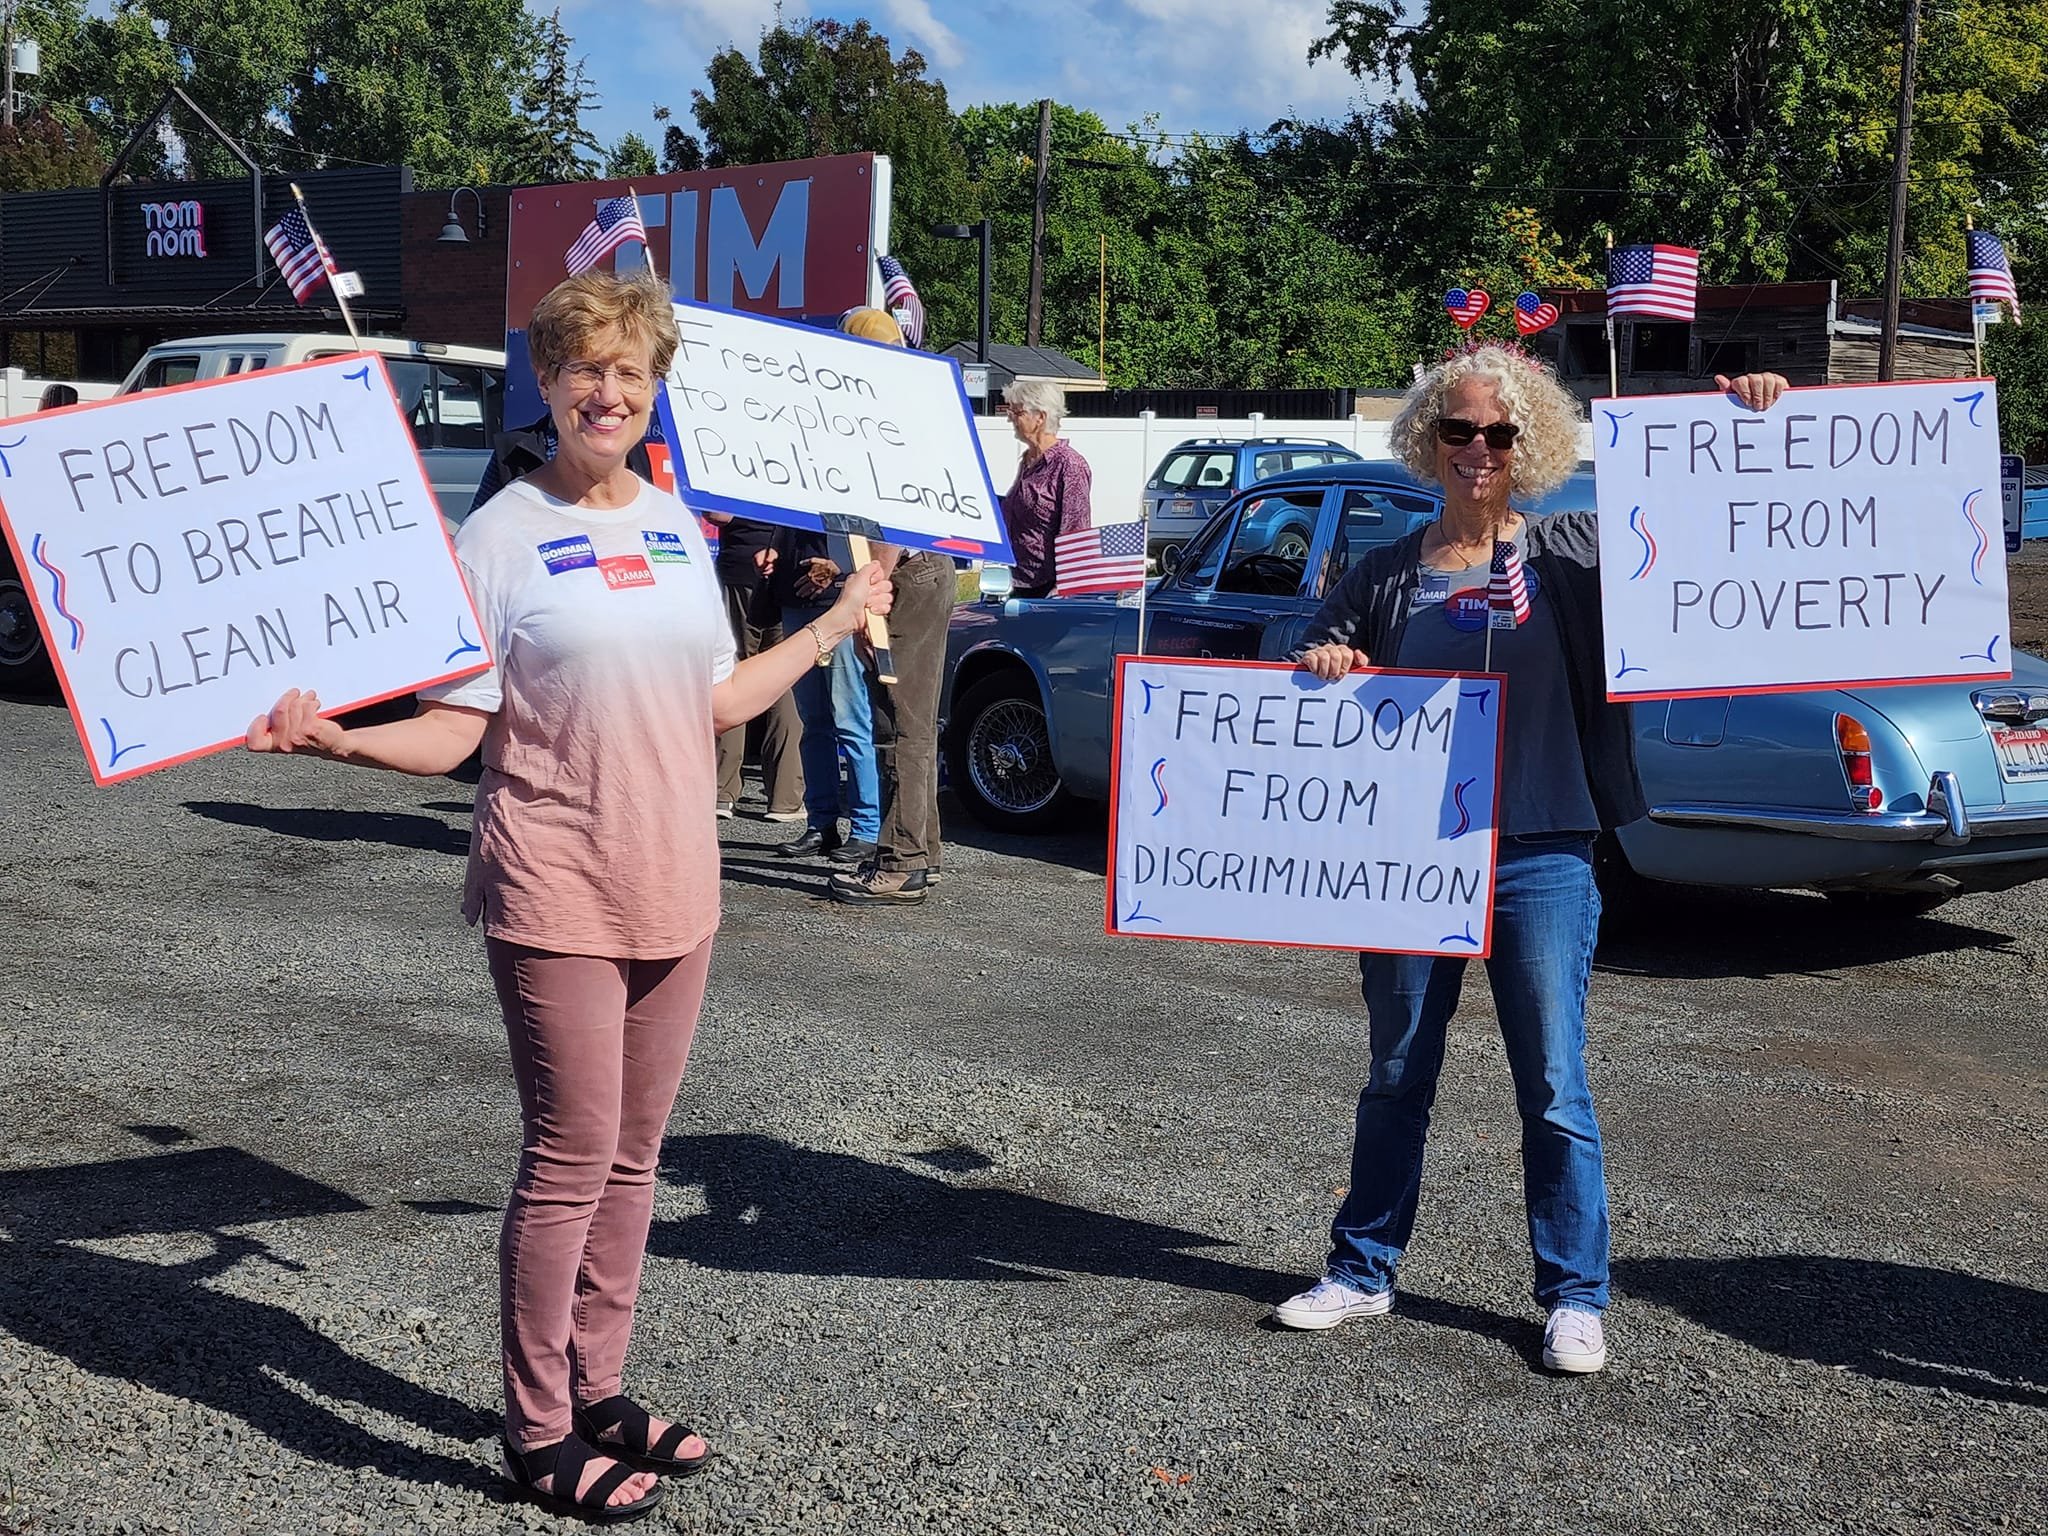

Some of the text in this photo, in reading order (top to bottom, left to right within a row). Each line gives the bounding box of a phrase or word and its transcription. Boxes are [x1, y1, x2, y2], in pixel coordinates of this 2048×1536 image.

[140, 201, 203, 229] nom
[147, 230, 207, 257] nom
[674, 319, 877, 400] Freedom
[671, 371, 906, 452] to explore
[58, 402, 344, 512] FREEDOM
[694, 427, 982, 520] Public Lands
[1644, 408, 1950, 478] FREEDOM
[81, 479, 418, 603] TO BREATHE
[541, 542, 592, 561] BOHMAN
[1728, 495, 1877, 553] FROM
[617, 569, 652, 582] LAMAR
[1414, 588, 1447, 601] LAMAR
[1458, 598, 1489, 610] TIM
[1672, 573, 1946, 634] POVERTY
[115, 580, 408, 698] CLEAN AIR
[1174, 689, 1452, 754] FREEDOM
[2015, 730, 2041, 740] IDAHO
[1222, 769, 1378, 826] FROM
[1135, 844, 1481, 905] DISCRIMINATION
